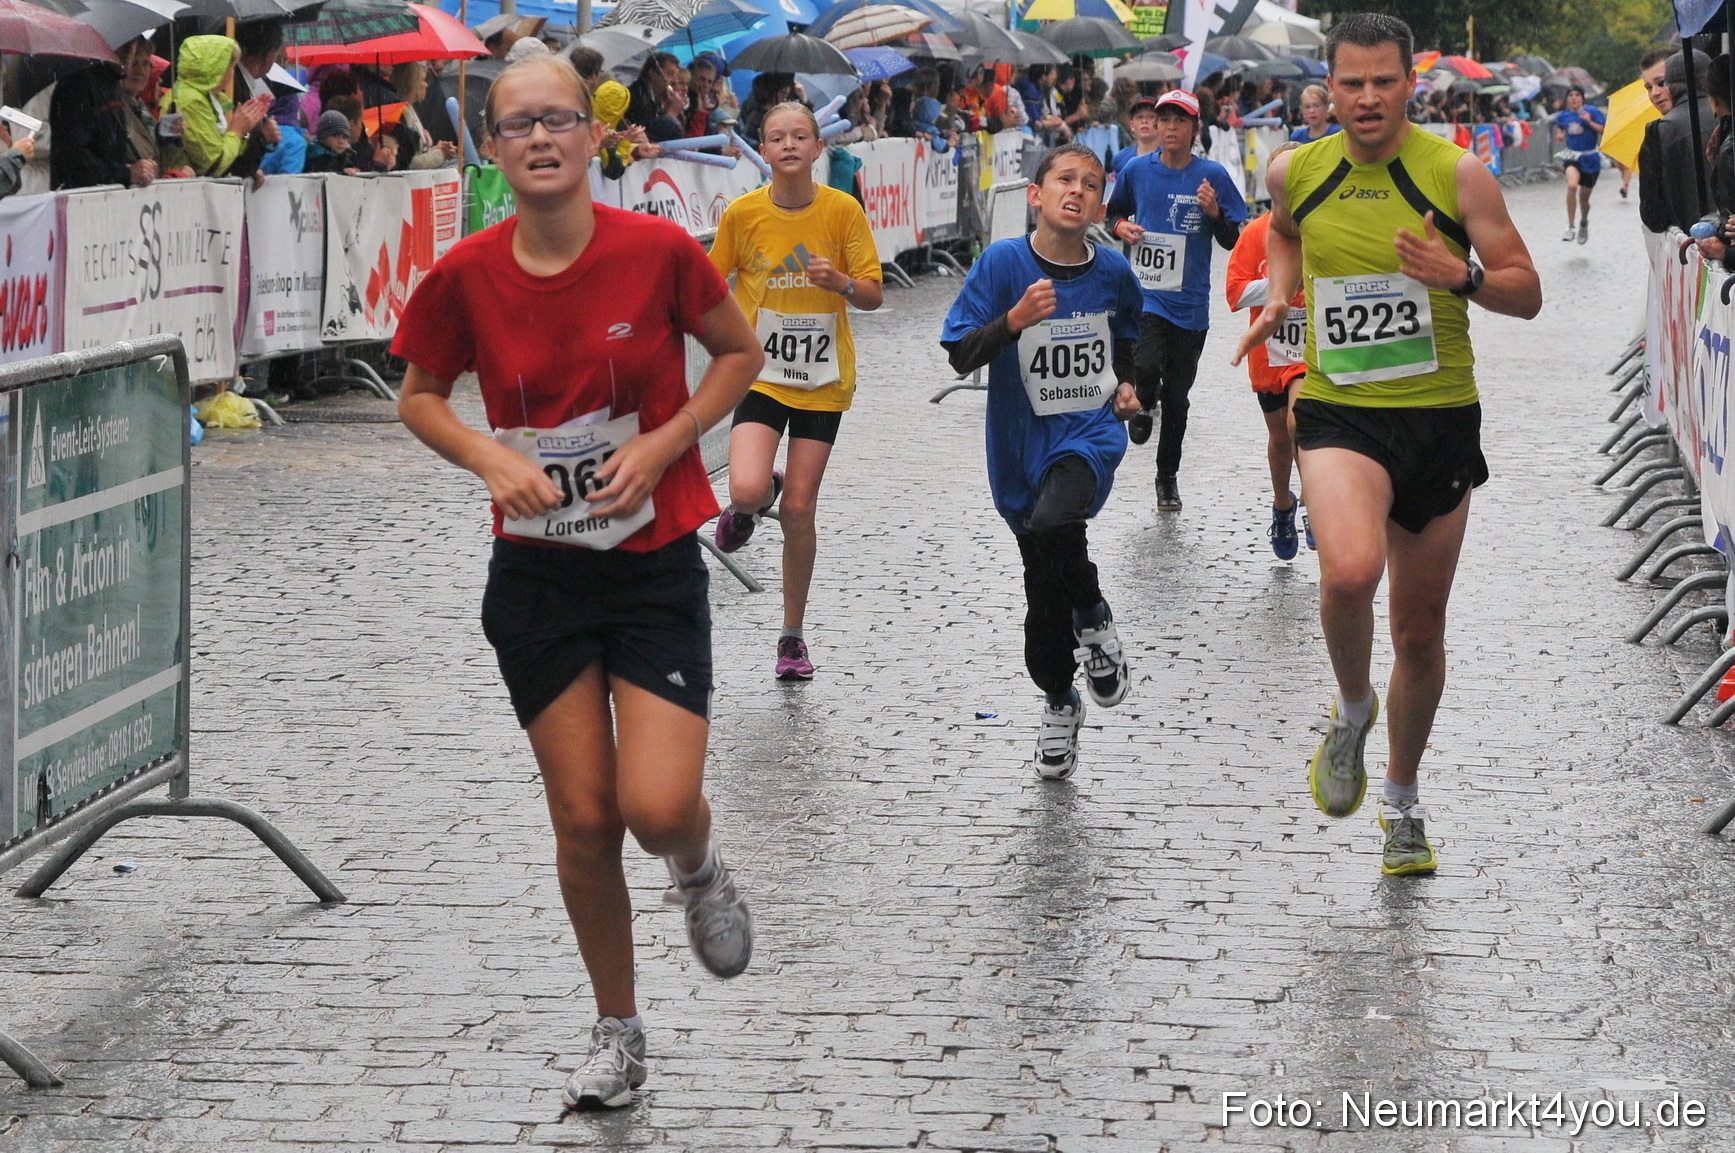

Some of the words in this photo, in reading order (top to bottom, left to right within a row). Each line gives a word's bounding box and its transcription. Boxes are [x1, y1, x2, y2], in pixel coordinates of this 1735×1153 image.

[1356, 189, 1390, 200] asics
[83, 239, 136, 282] RECHTS
[166, 223, 231, 267] ANWÄLTE
[1139, 271, 1162, 282] David
[1344, 280, 1390, 294] BOCK
[782, 318, 816, 326] BOCK
[1051, 323, 1090, 335] BOCK
[1325, 300, 1421, 345] 5223
[1272, 322, 1307, 346] 407
[763, 332, 831, 363] 4012
[1286, 349, 1303, 358] Pas
[1029, 339, 1105, 379] 4053
[783, 368, 809, 381] Nina
[1039, 385, 1101, 401] Sebastian
[51, 415, 130, 462] Event-Leit-Systeme
[537, 432, 595, 449] BOCK
[543, 450, 618, 509] 06
[544, 516, 610, 537] Lorena
[55, 547, 67, 606] &
[70, 532, 114, 600] Action
[118, 524, 130, 582] in
[24, 638, 83, 710] sicheren
[87, 603, 141, 680] Bahnen!
[56, 750, 86, 795] Service
[88, 740, 107, 778] Line:
[109, 726, 132, 766] 09181
[133, 713, 153, 753] 6352
